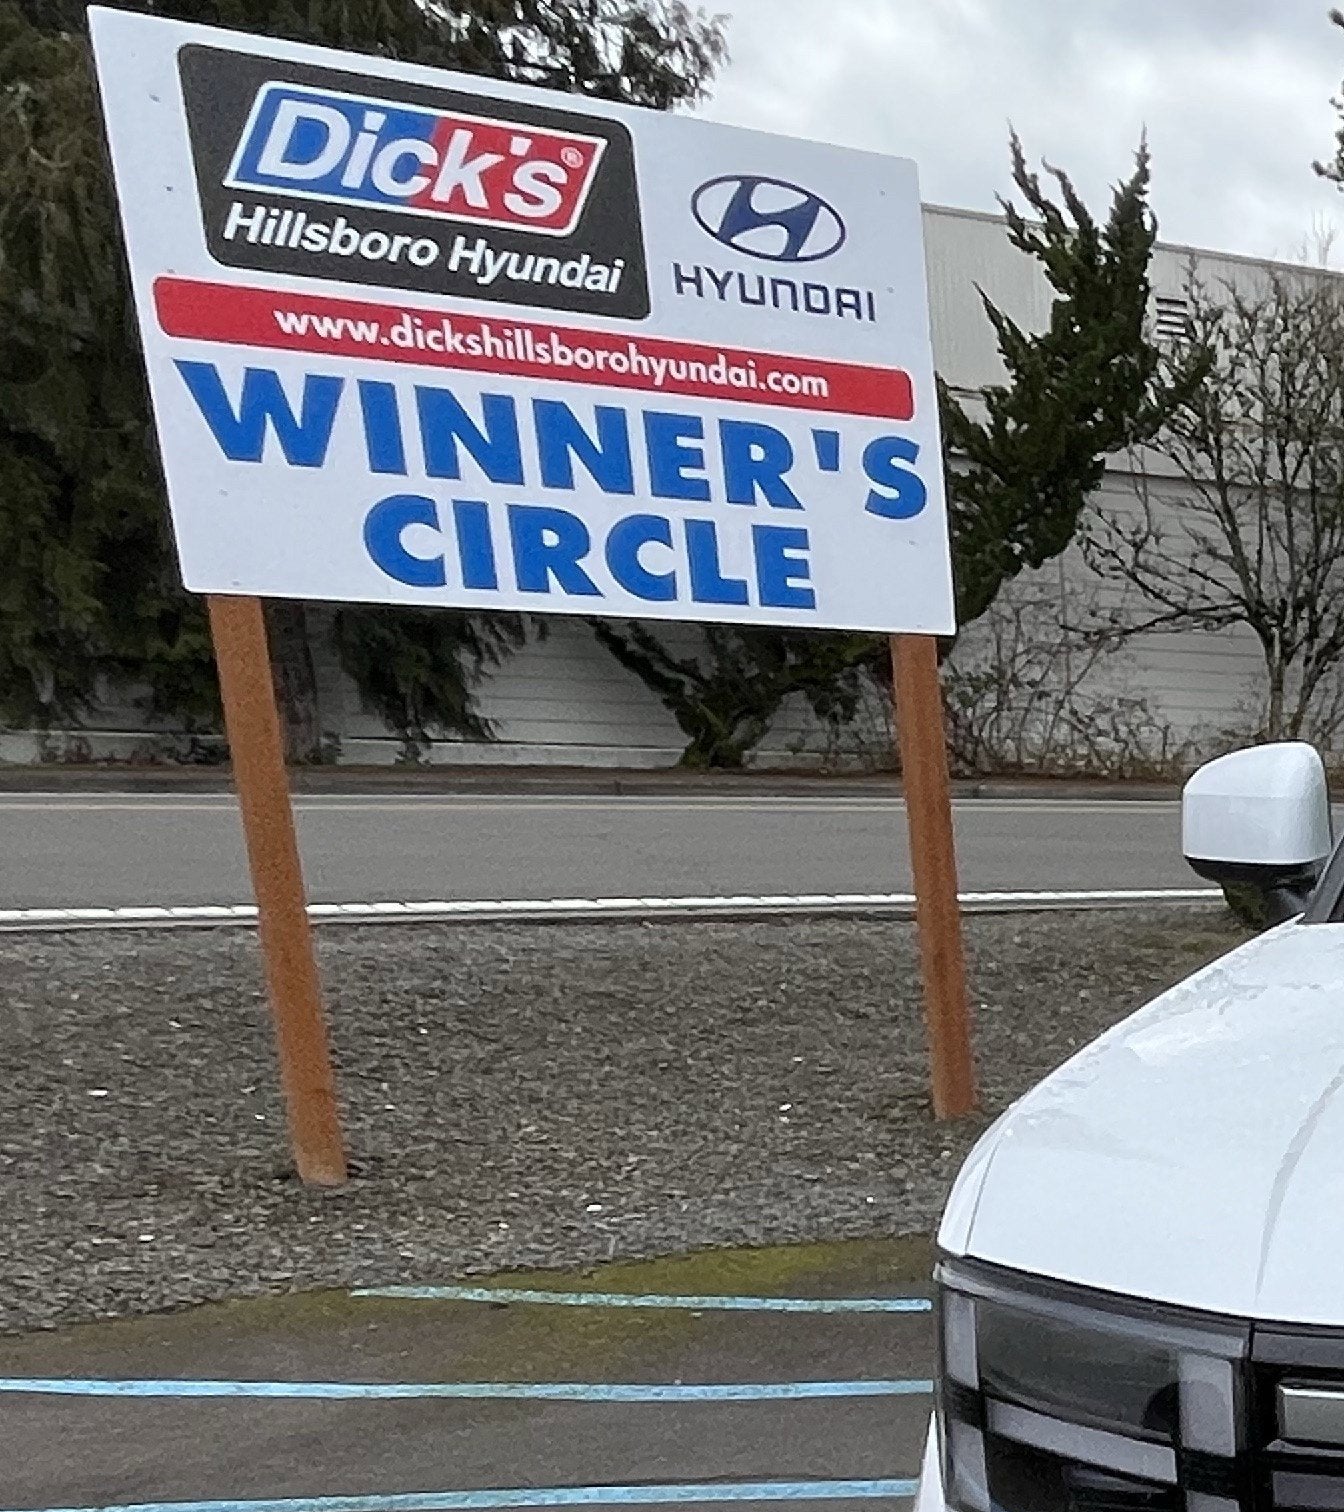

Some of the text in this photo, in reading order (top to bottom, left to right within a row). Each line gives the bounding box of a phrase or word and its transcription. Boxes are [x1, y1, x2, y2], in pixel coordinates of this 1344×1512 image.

[256, 97, 568, 220] Dick's
[223, 202, 626, 296] Hillsboro Hyundai
[674, 262, 876, 323] HYUNDAI
[273, 307, 830, 399] www.dickshillsborohyundai.com
[173, 357, 928, 521] WINNER'S
[362, 494, 817, 610] CIRCLE
